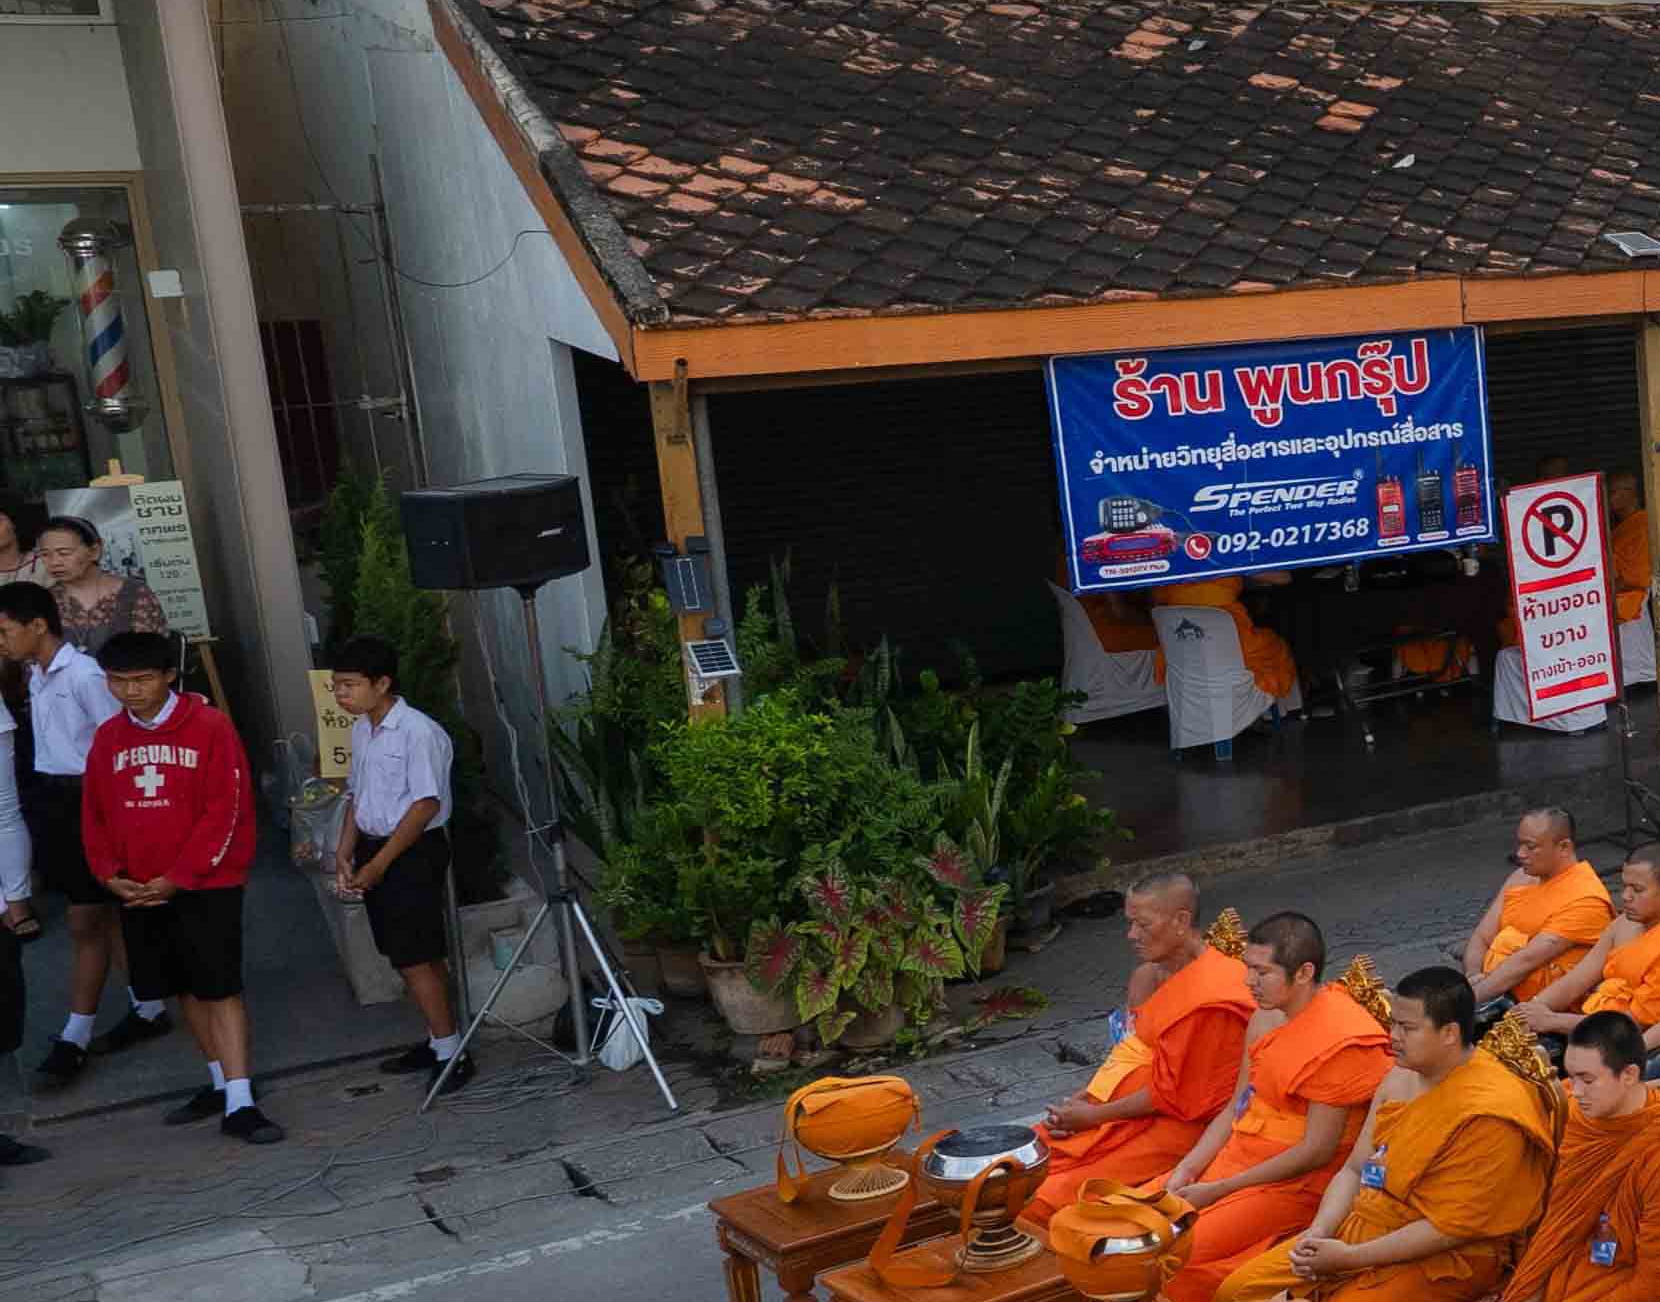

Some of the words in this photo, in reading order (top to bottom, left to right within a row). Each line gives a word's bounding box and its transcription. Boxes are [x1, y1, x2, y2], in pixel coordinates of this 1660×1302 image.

[1113, 357, 1225, 420] ร้าน
[1234, 338, 1432, 427] พูนกรุ๊ป
[1088, 416, 1464, 476] จำหน่ายวิทยุสื่อสารและอุปกรณ์สื่อสาร
[136, 505, 183, 519] ชาย
[1188, 478, 1361, 513] SPENDER
[1229, 508, 1247, 518] The
[1248, 504, 1282, 516] Perfect
[1284, 501, 1304, 511] Two
[1327, 496, 1358, 507] Radios
[1216, 517, 1370, 555] 092-0217368
[1540, 503, 1575, 557] P
[1522, 588, 1601, 622] ห้ามจอด
[1539, 623, 1588, 650] ขวาง
[1531, 651, 1607, 683] ทางเข้า-ออก
